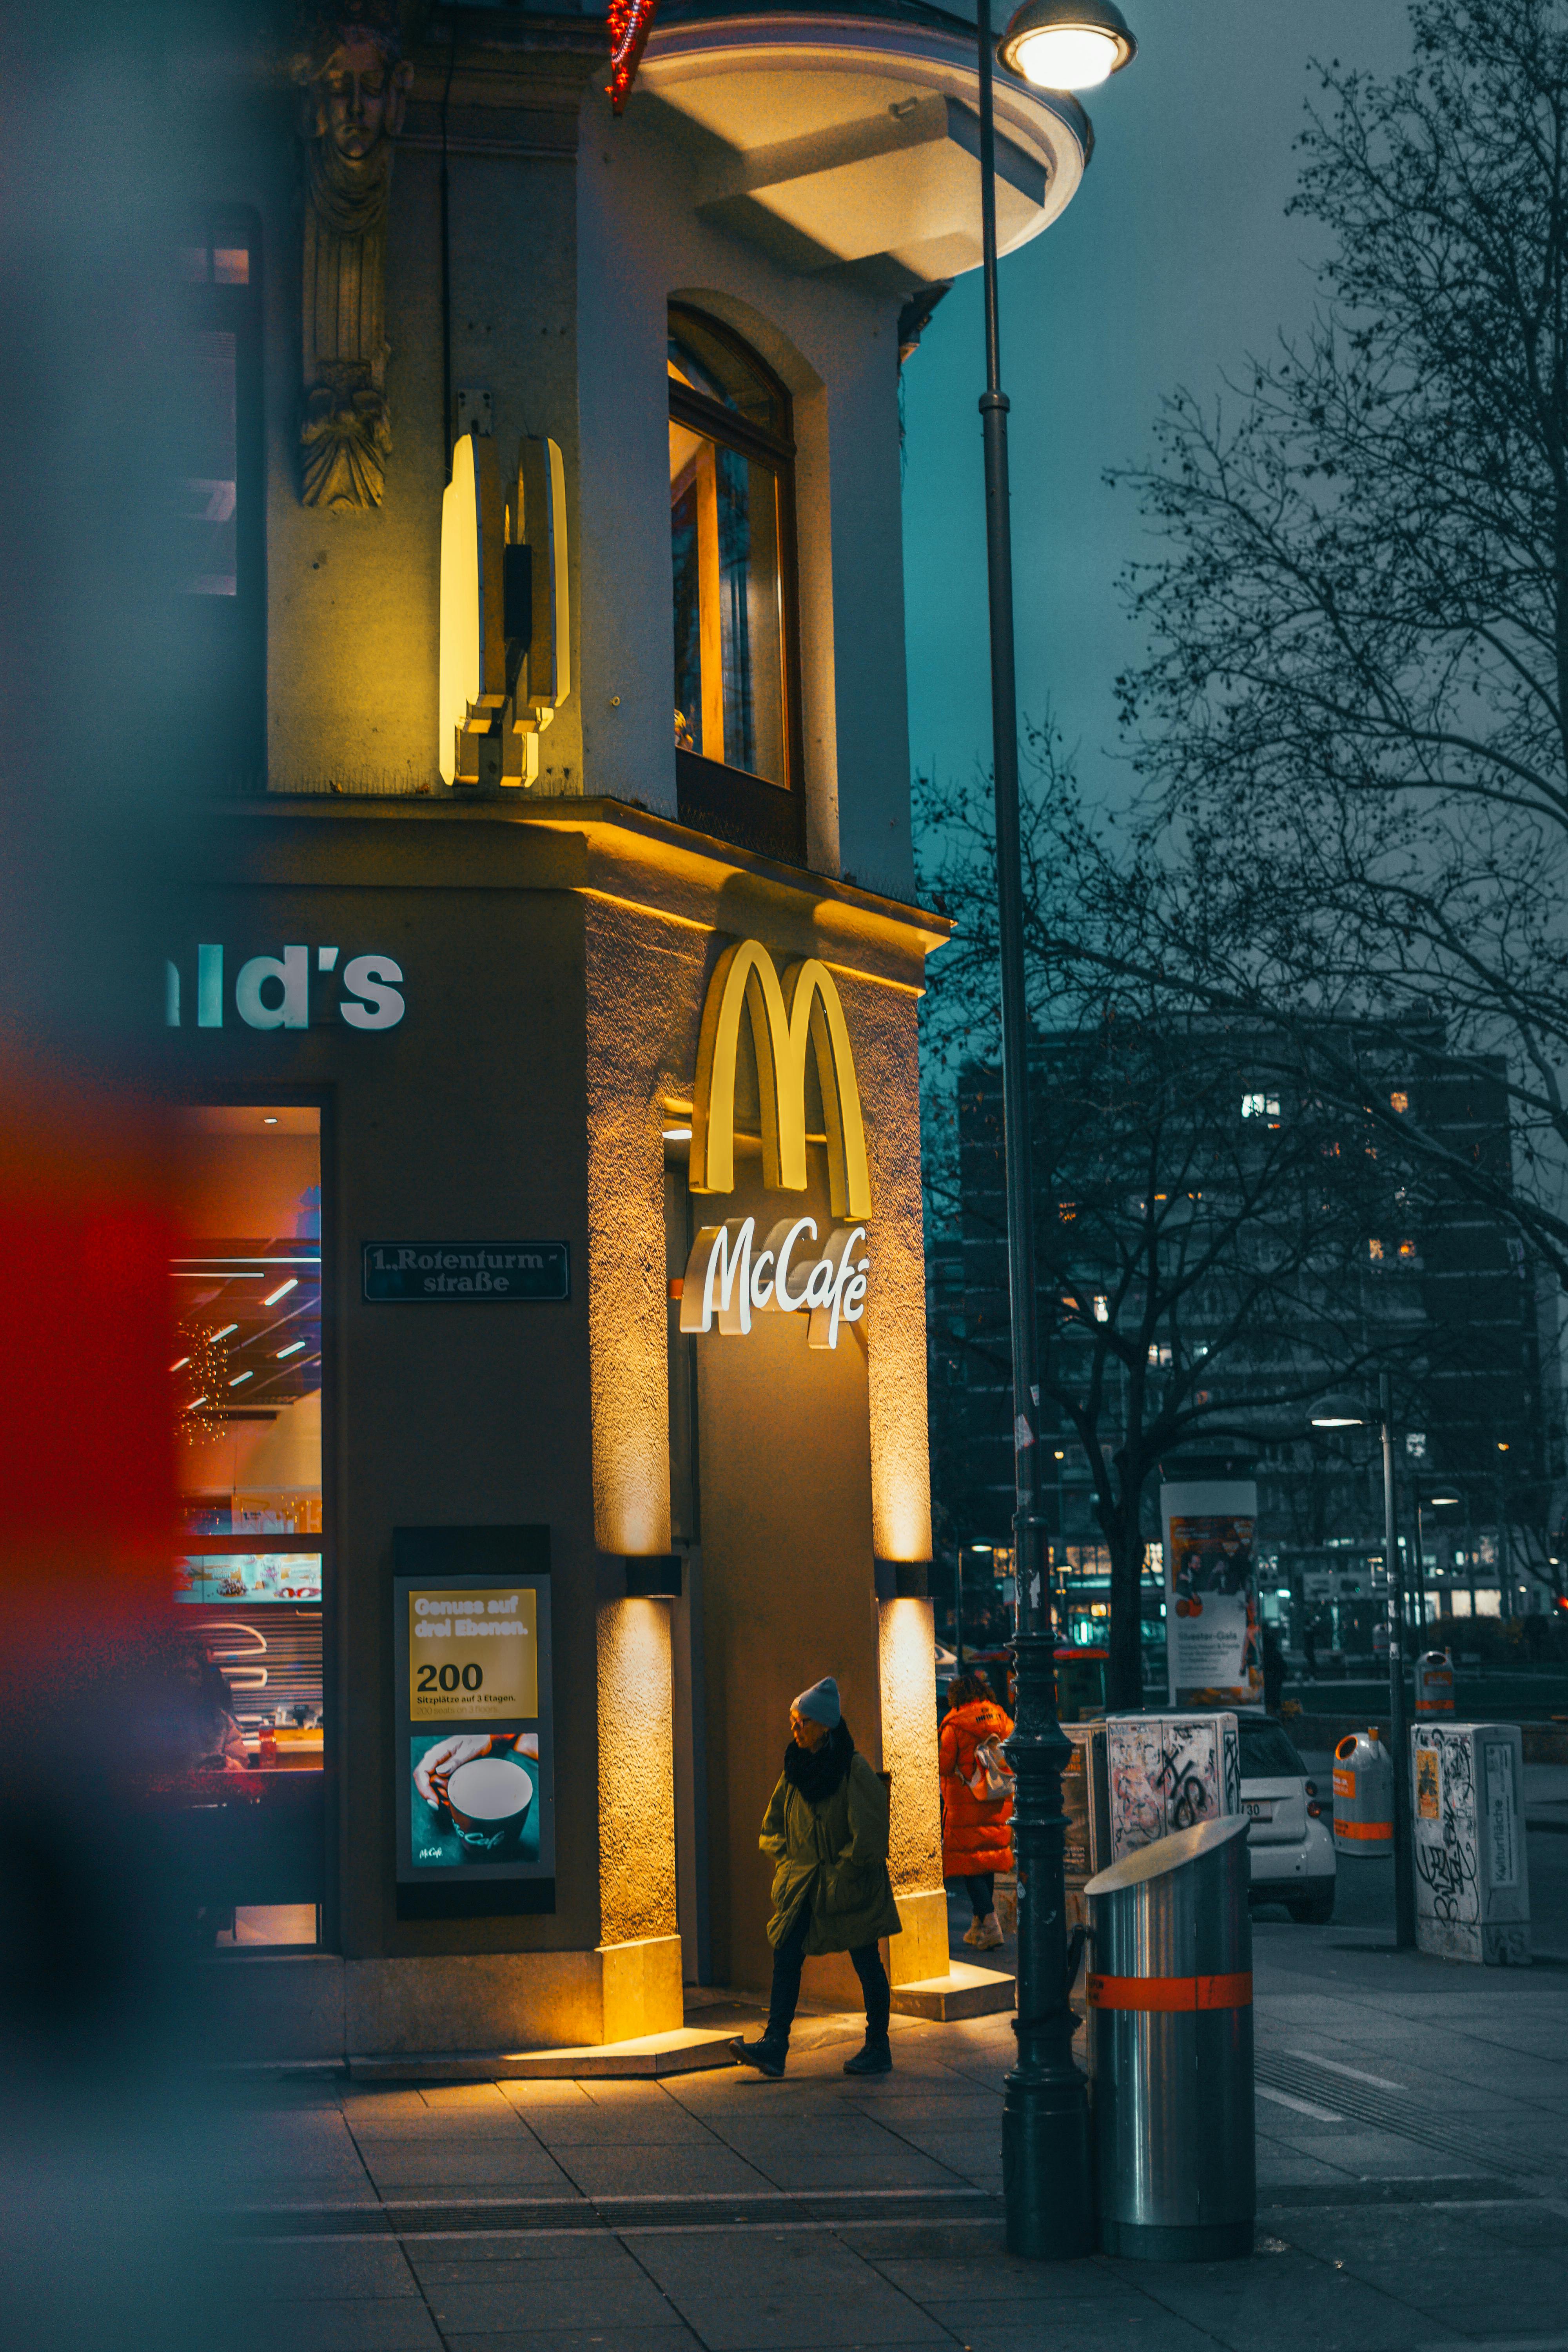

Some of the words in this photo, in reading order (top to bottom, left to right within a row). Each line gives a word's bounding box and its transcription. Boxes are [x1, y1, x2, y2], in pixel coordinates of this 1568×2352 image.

[423, 1271, 510, 1292] straße
[701, 1217, 869, 1349] McCafé
[415, 1598, 485, 1616] Genuss
[487, 1595, 519, 1614] auf
[415, 1618, 451, 1638] drei
[417, 1663, 483, 1692] 200
[417, 1695, 459, 1705] Sitzplätze
[484, 1695, 516, 1704] Etagen.
[1494, 1798, 1506, 1883] Kulturfläche
